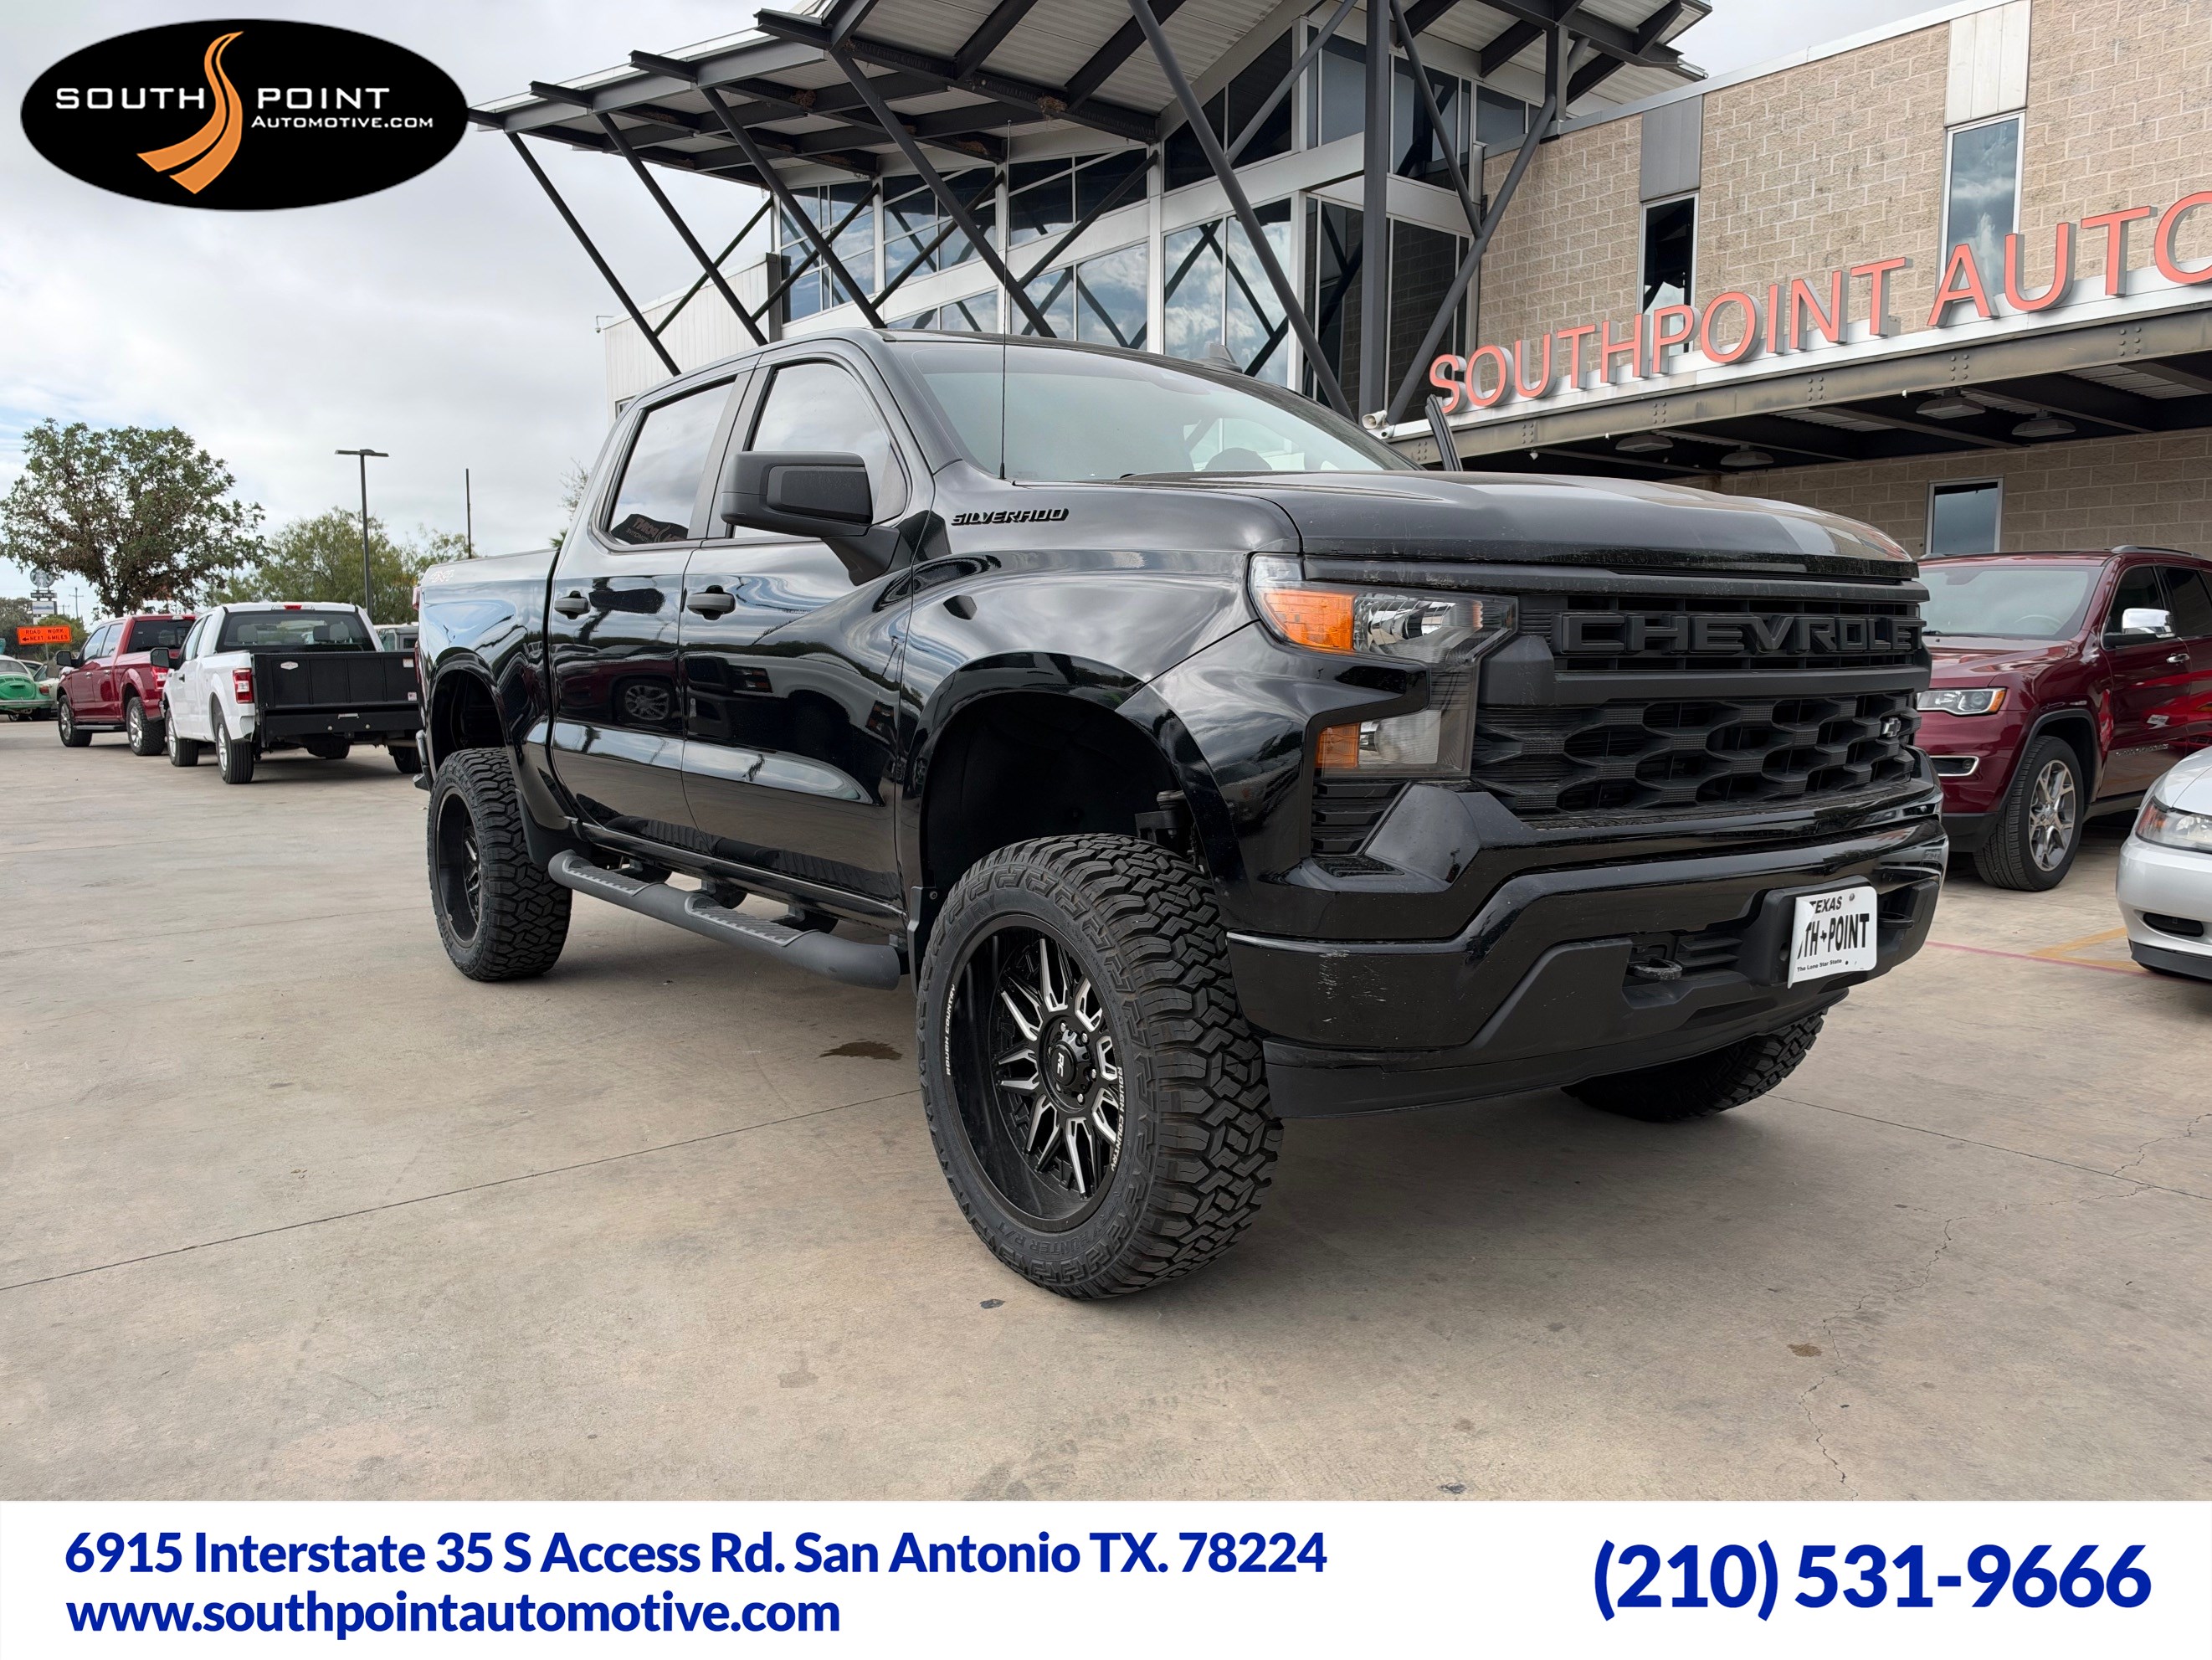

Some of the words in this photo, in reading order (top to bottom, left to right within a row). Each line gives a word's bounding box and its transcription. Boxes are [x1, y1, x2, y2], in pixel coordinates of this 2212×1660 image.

[1429, 257, 1912, 414] SOUTHPOINT
[952, 508, 1069, 526] SILVERADO
[1828, 913, 1870, 953] POINT
[945, 984, 956, 1034] COUNTRY
[1111, 1114, 1124, 1172] COUNTRY
